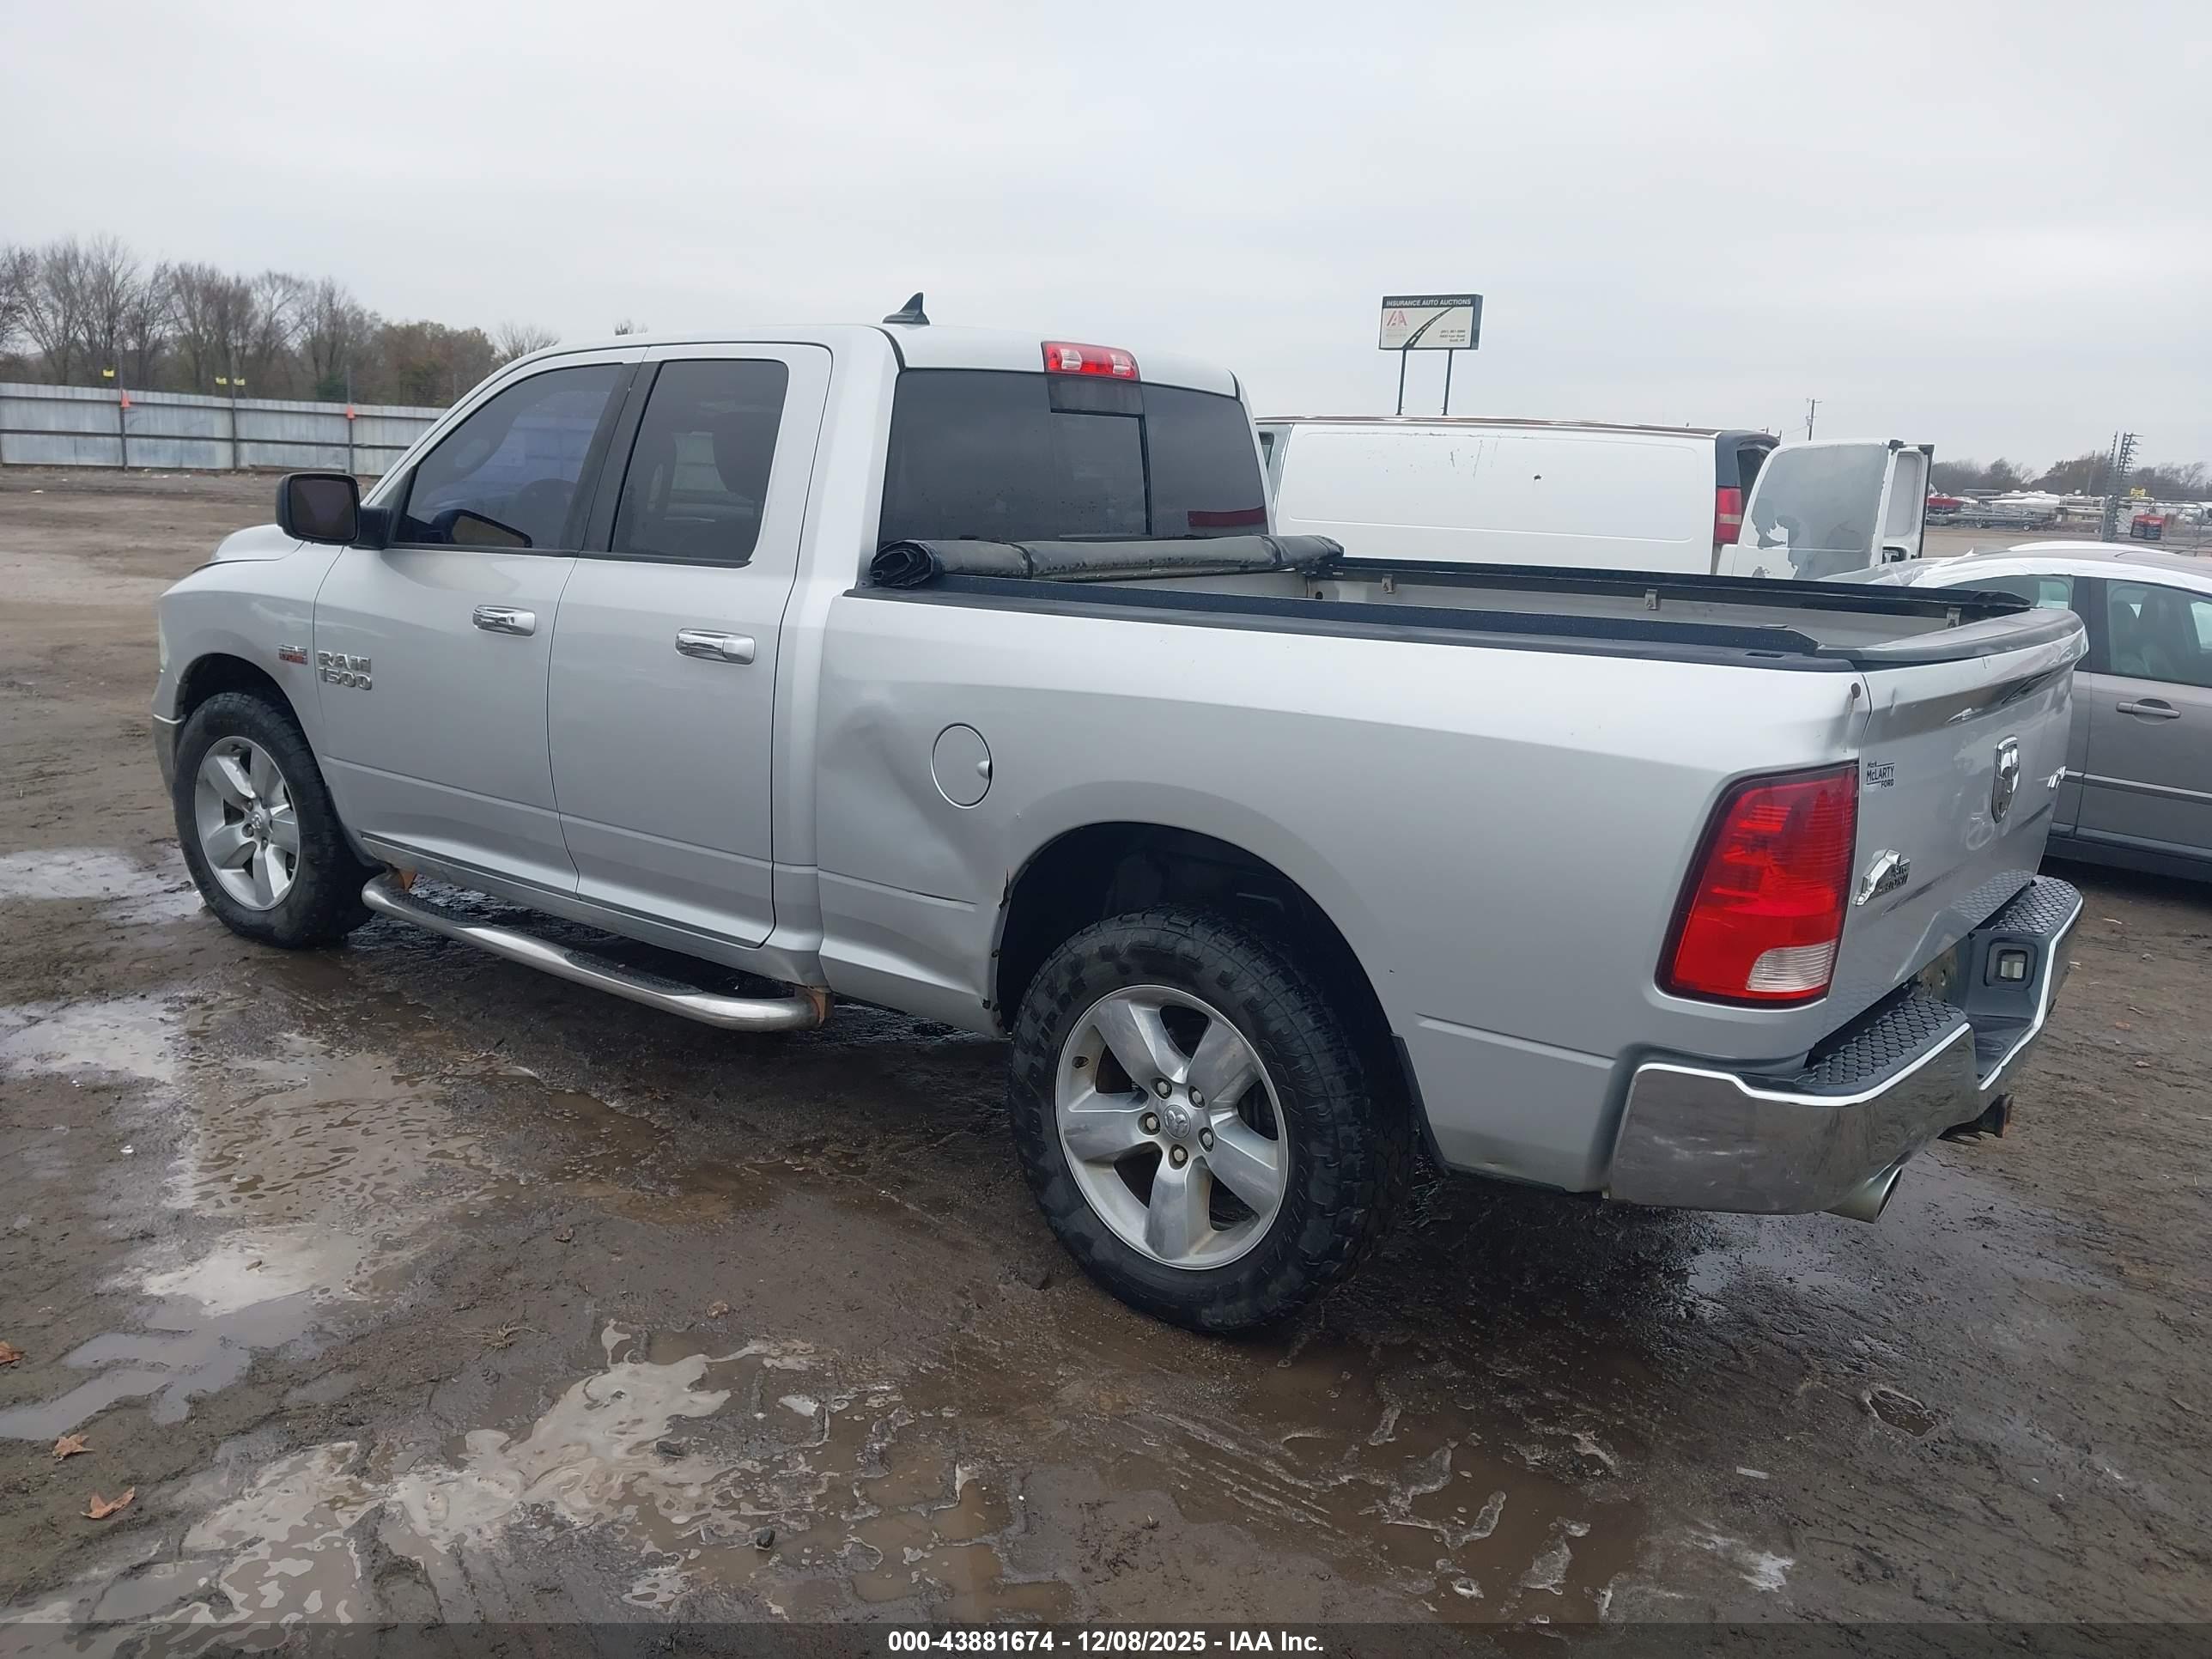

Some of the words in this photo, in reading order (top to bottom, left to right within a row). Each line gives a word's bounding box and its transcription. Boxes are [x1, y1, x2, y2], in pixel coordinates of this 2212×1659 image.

[318, 650, 371, 673] RAM
[318, 667, 372, 690] 1500
[1867, 765, 1895, 782] McLARTY
